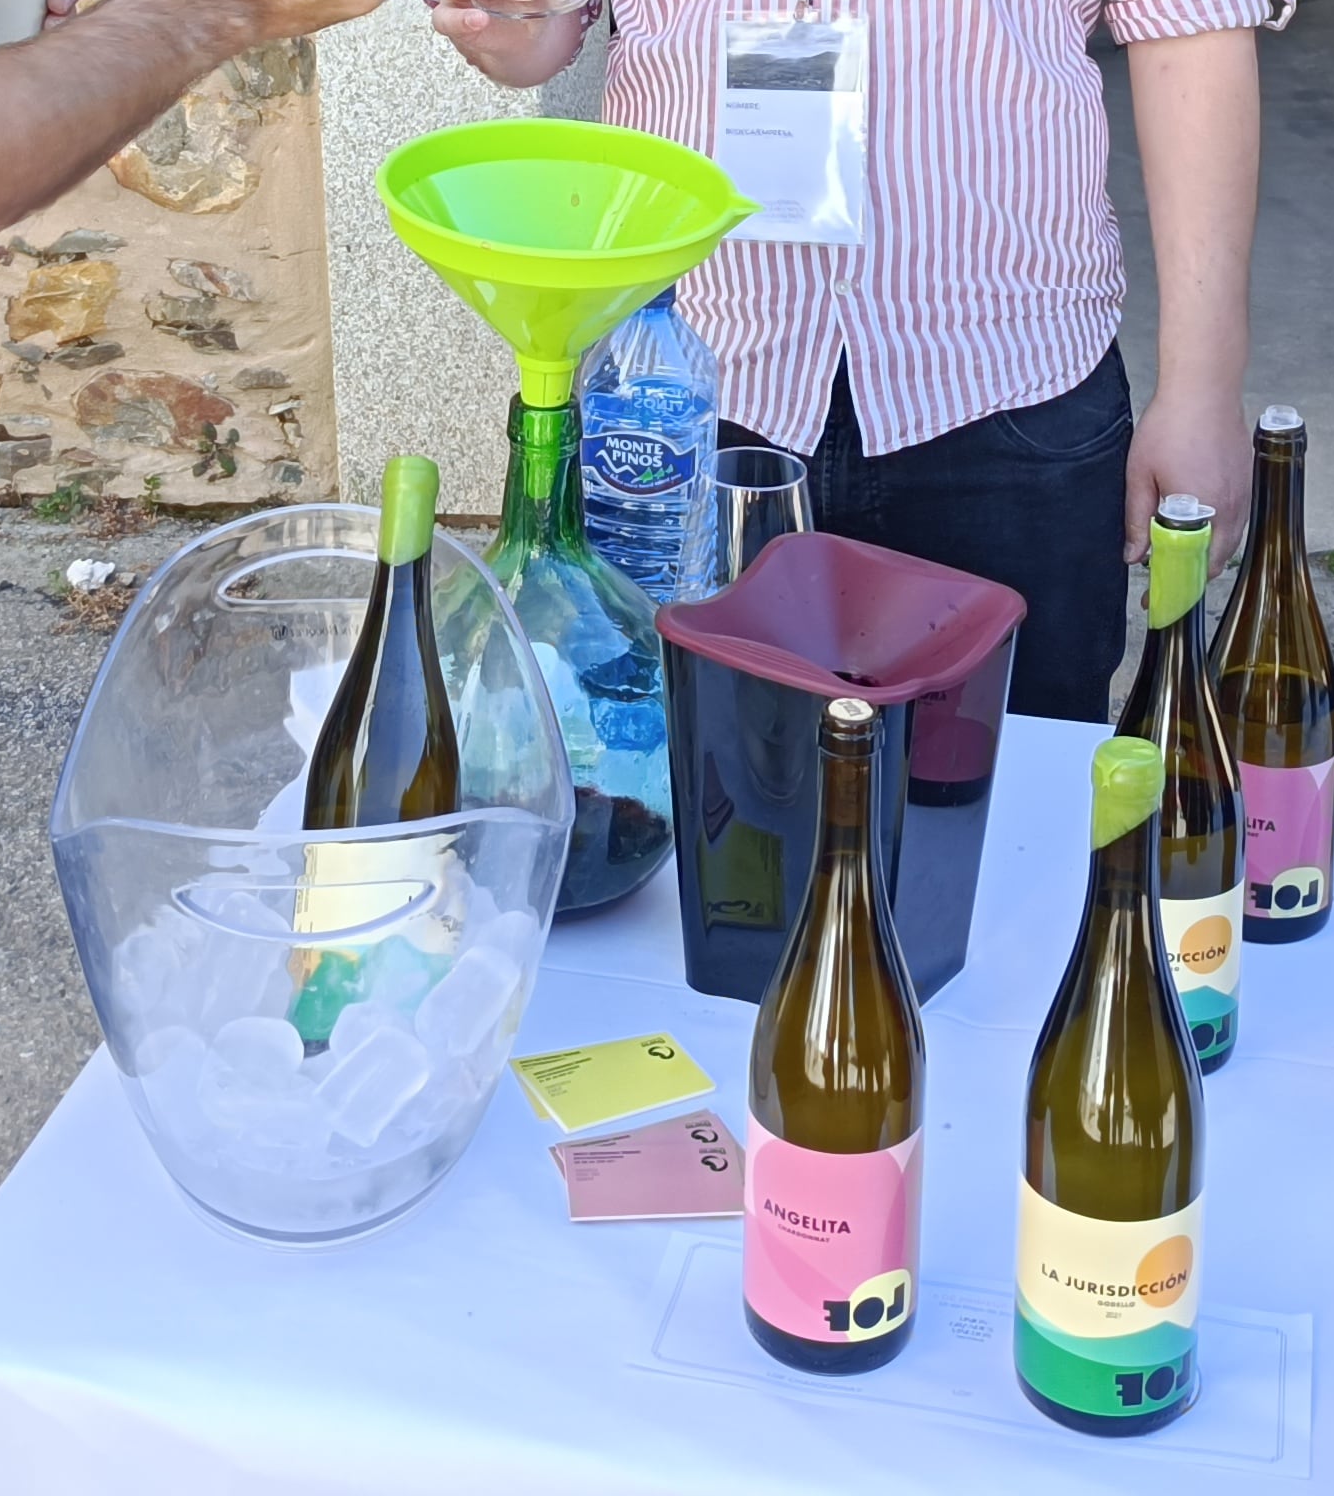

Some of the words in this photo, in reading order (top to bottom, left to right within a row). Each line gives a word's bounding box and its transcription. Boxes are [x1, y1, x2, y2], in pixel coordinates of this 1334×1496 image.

[606, 436, 664, 455] MONTE
[612, 449, 663, 468] PINOS
[763, 1198, 851, 1234] ANGELITA
[1041, 1263, 1060, 1282] LA
[1064, 1270, 1188, 1298] JURISDICCIÓN
